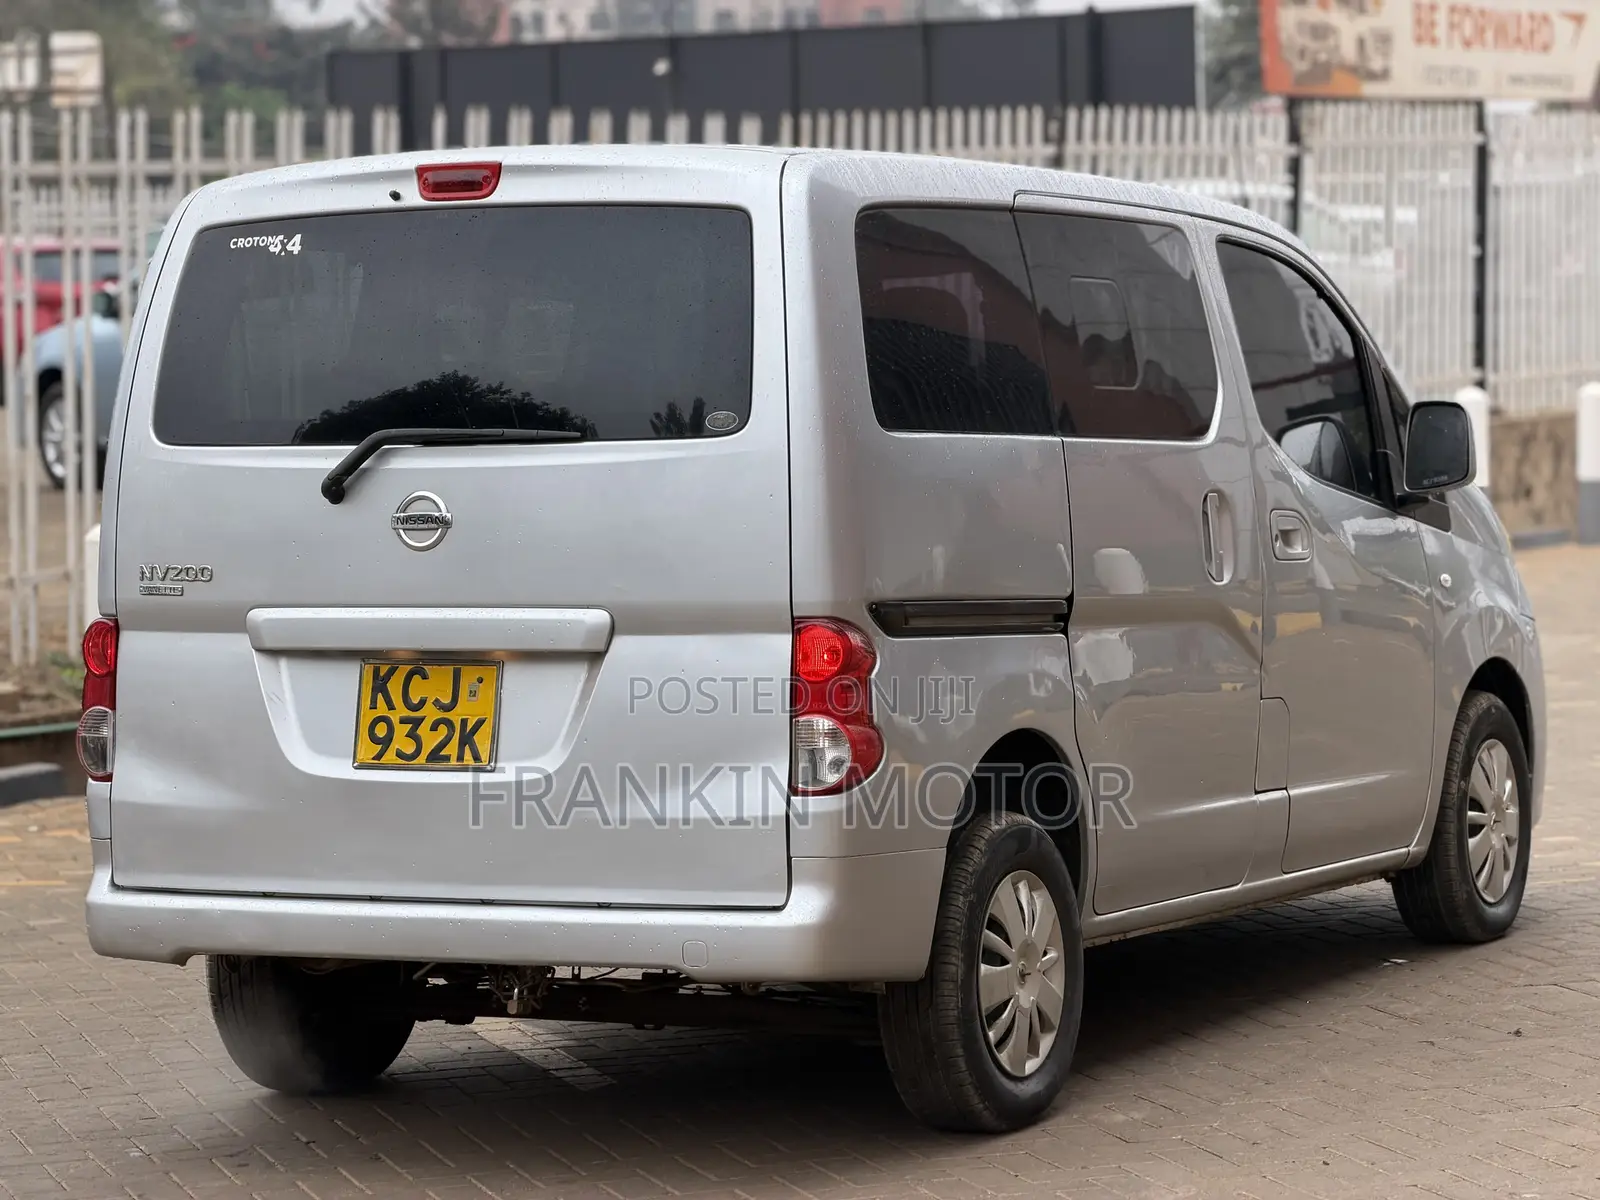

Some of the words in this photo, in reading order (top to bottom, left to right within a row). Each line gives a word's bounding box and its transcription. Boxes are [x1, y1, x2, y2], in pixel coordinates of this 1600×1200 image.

[1412, 1, 1440, 48] BE
[1446, 4, 1555, 55] FORWARD
[396, 515, 444, 526] NISSAN
[139, 564, 213, 583] NV200
[369, 665, 462, 713] KCJ
[367, 715, 488, 764] 932K
